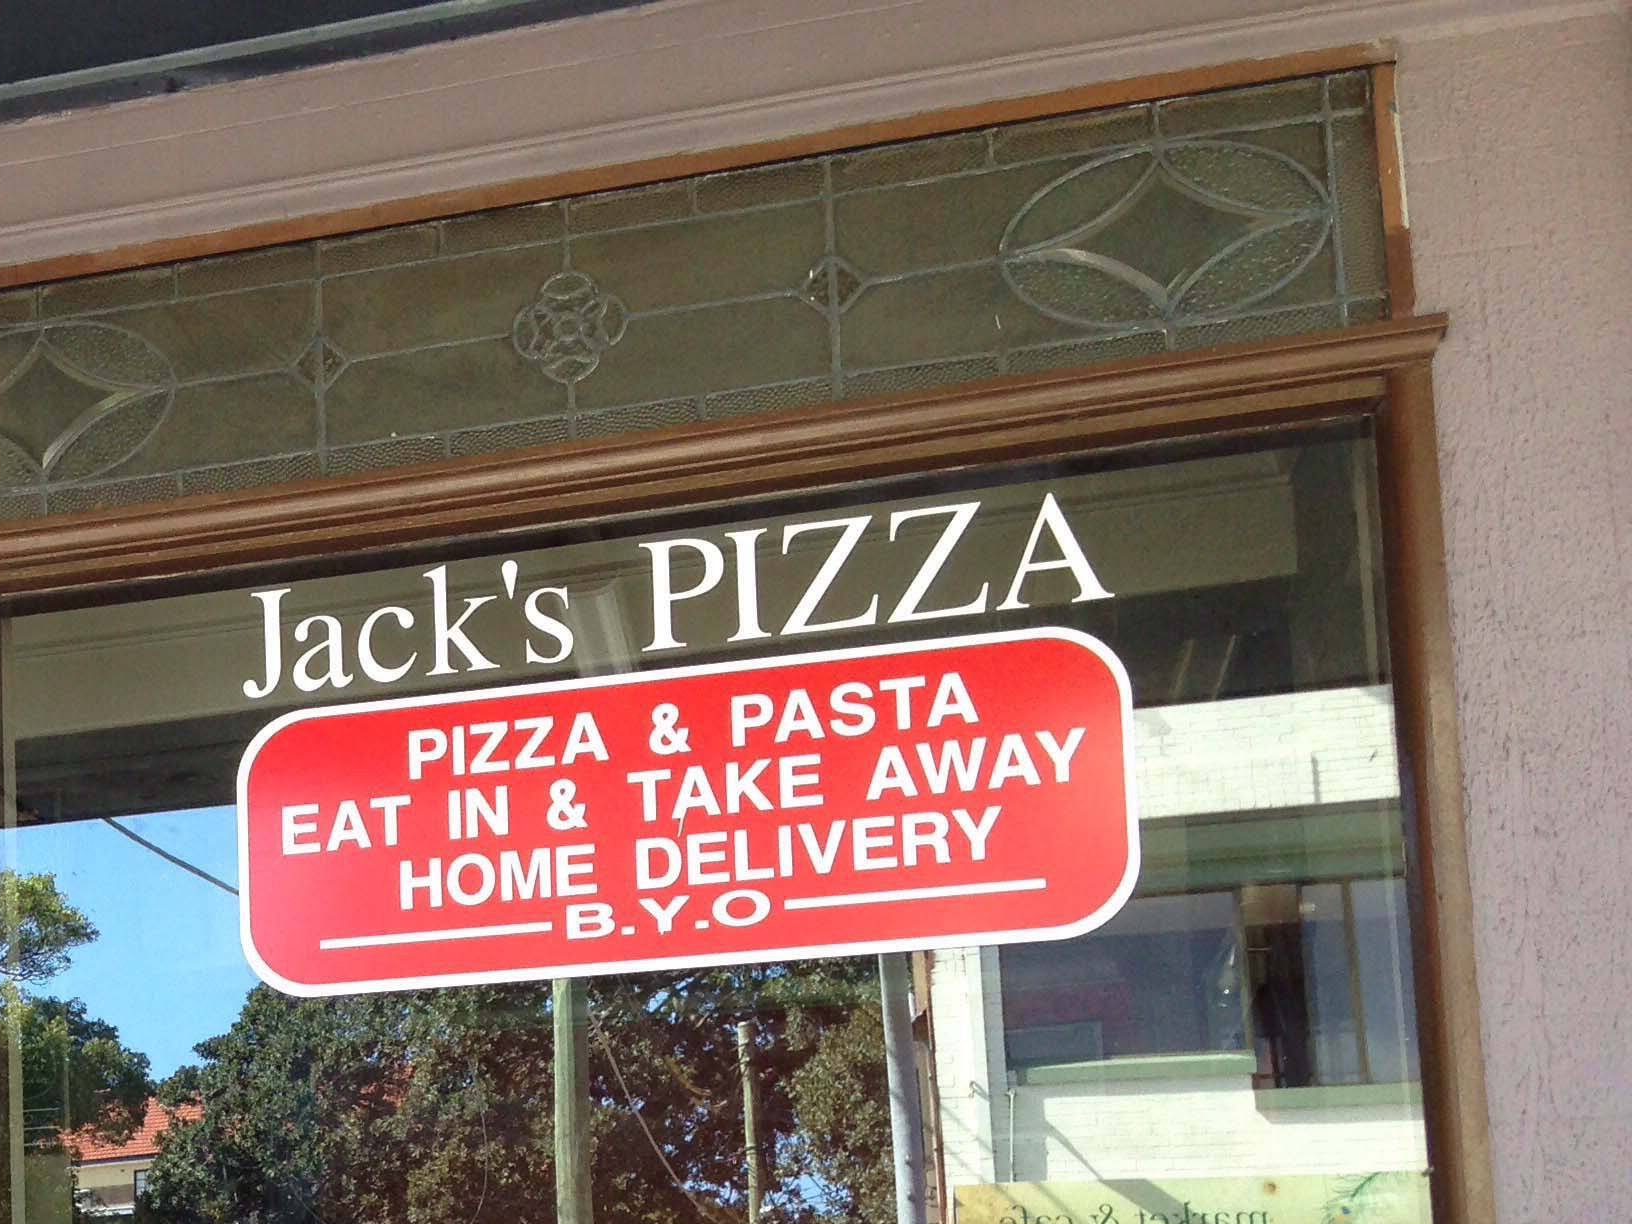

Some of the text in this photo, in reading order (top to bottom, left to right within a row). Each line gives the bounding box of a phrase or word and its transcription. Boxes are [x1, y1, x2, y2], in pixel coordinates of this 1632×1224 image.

[243, 492, 1114, 698] Jack's PIZZA
[408, 672, 979, 780] PIZZA & PASTA
[282, 728, 1086, 856] EAT IN & TAKE AWAY
[400, 806, 1002, 911] HOME DELIVERY
[566, 889, 771, 940] B.Y.O
